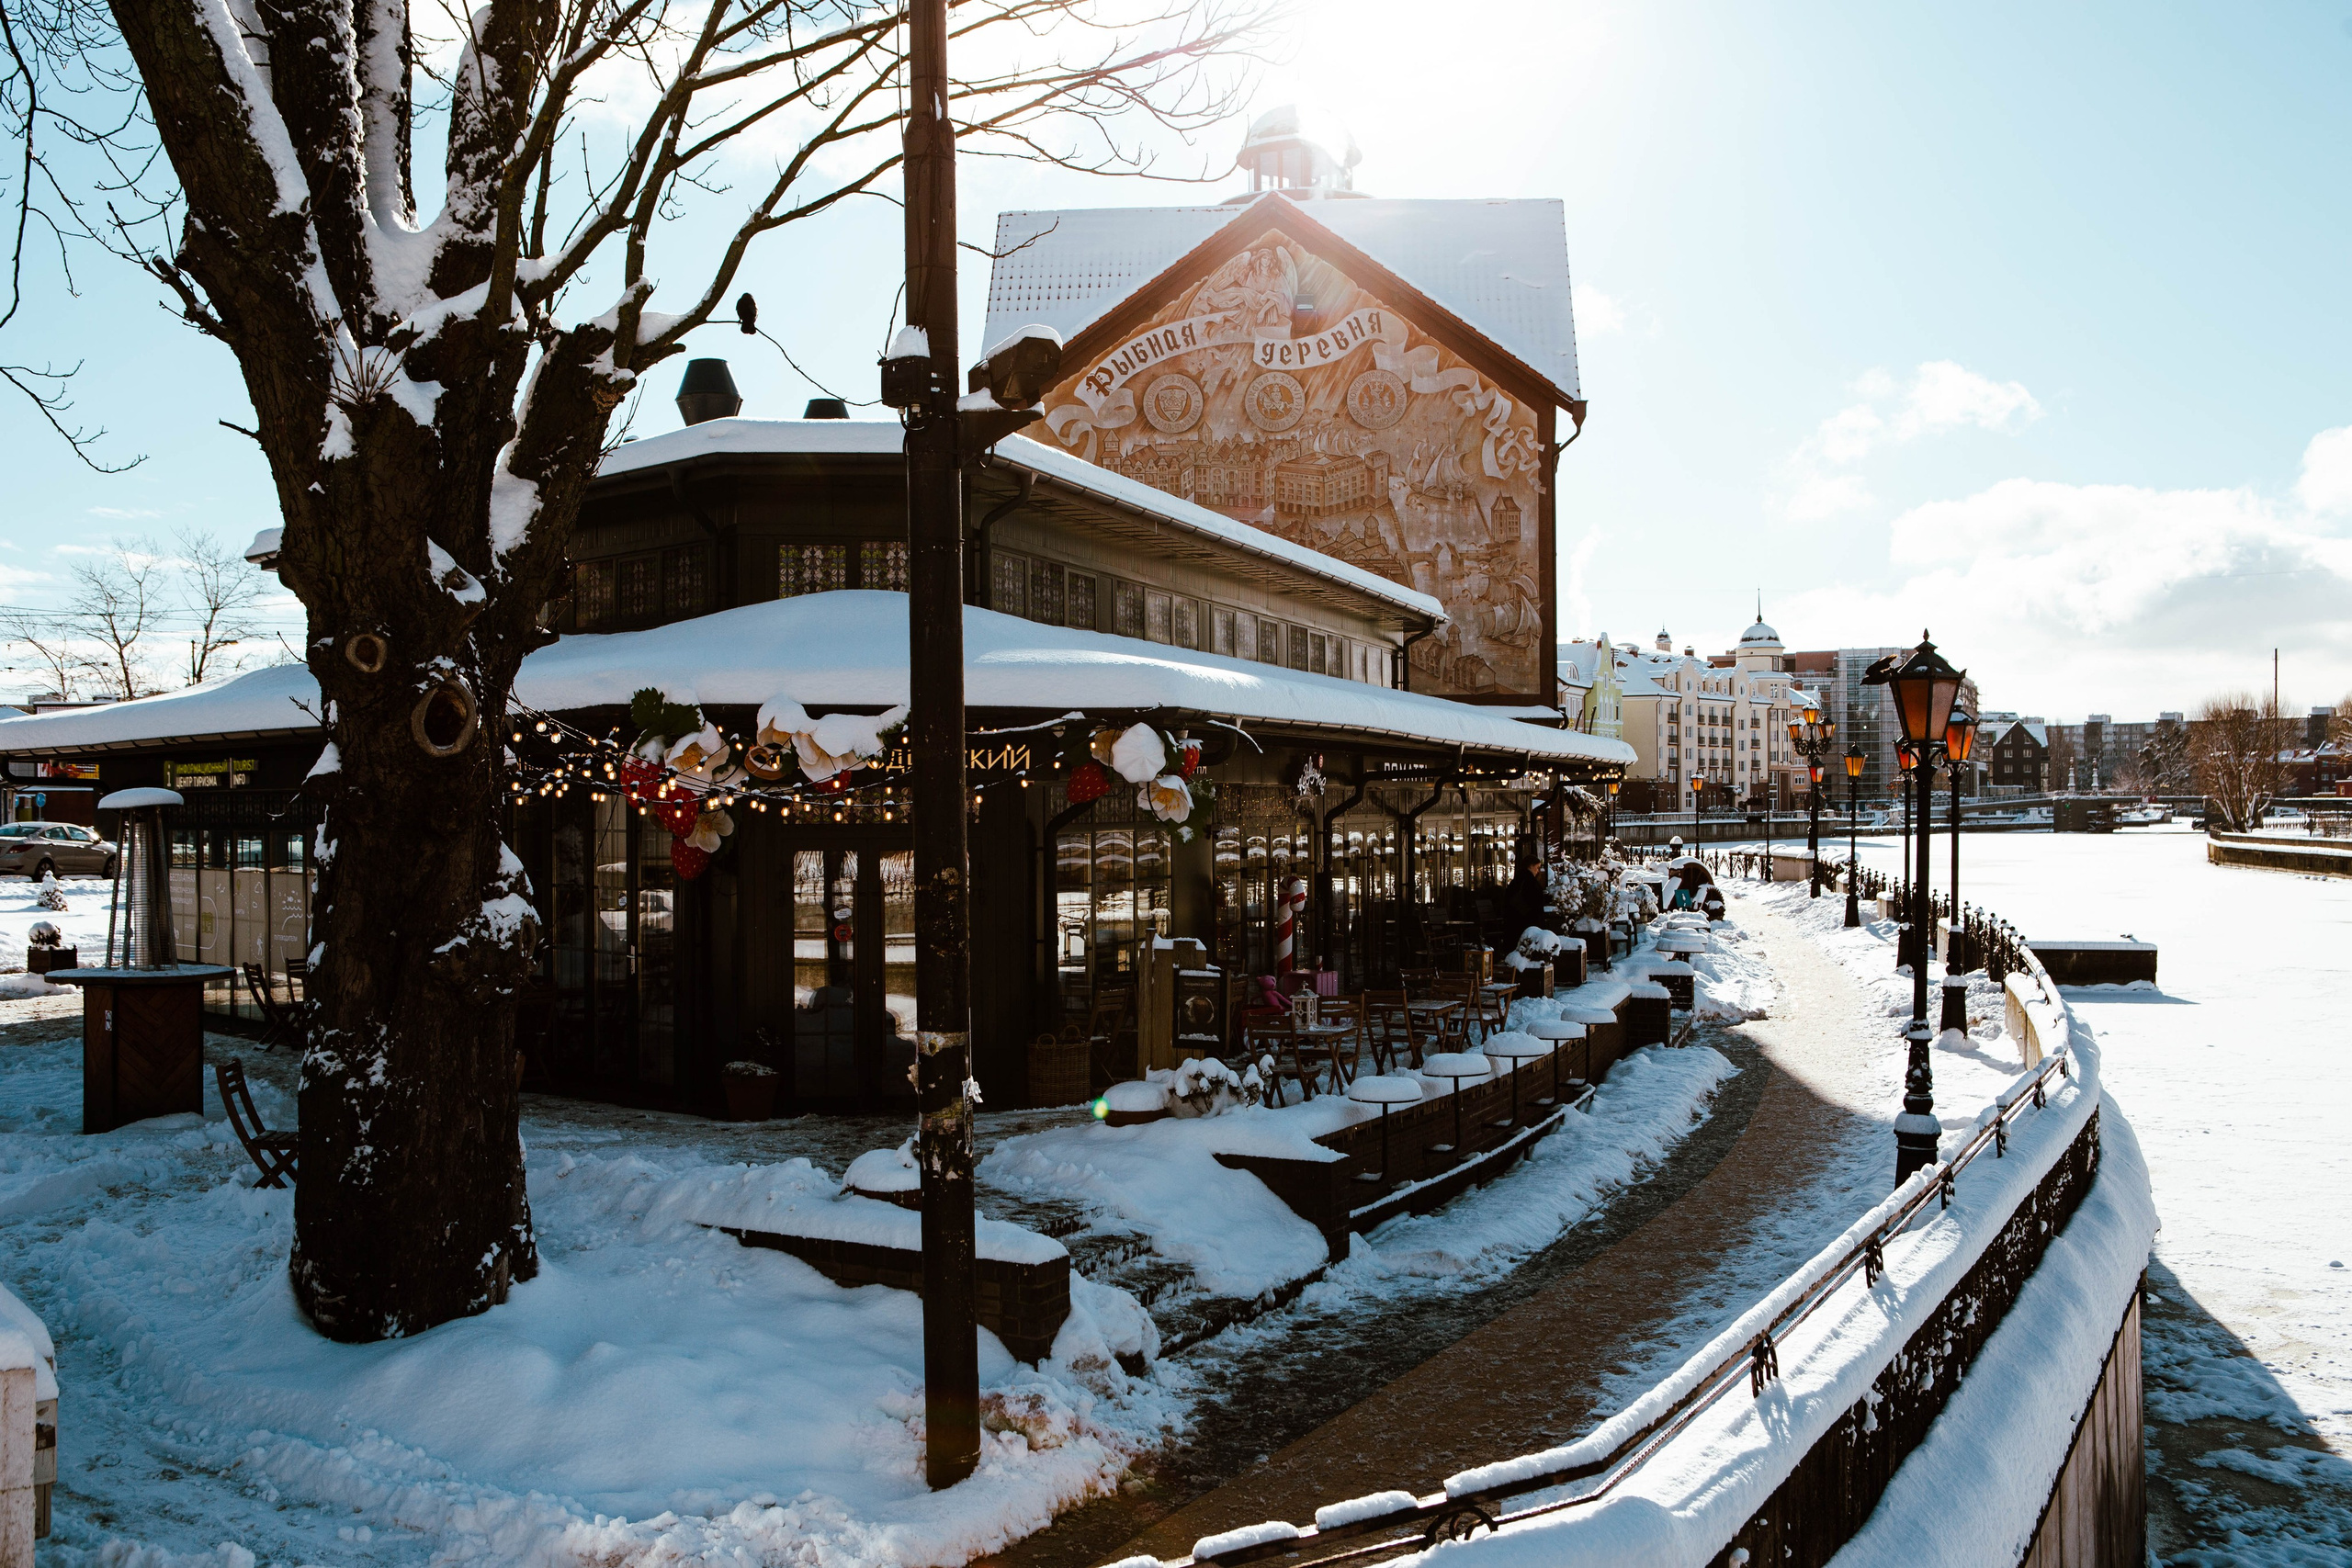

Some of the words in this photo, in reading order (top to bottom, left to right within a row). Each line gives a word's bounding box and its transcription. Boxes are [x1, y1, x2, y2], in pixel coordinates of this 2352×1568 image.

[1259, 310, 1384, 366] деревня
[175, 759, 228, 774] ИНФОРМАЦИОННЫЙ
[232, 759, 254, 772] TOURIST
[175, 774, 193, 789] ЦЕНТР
[193, 774, 218, 787] ТУРИЗМА
[232, 773, 246, 786] INFO
